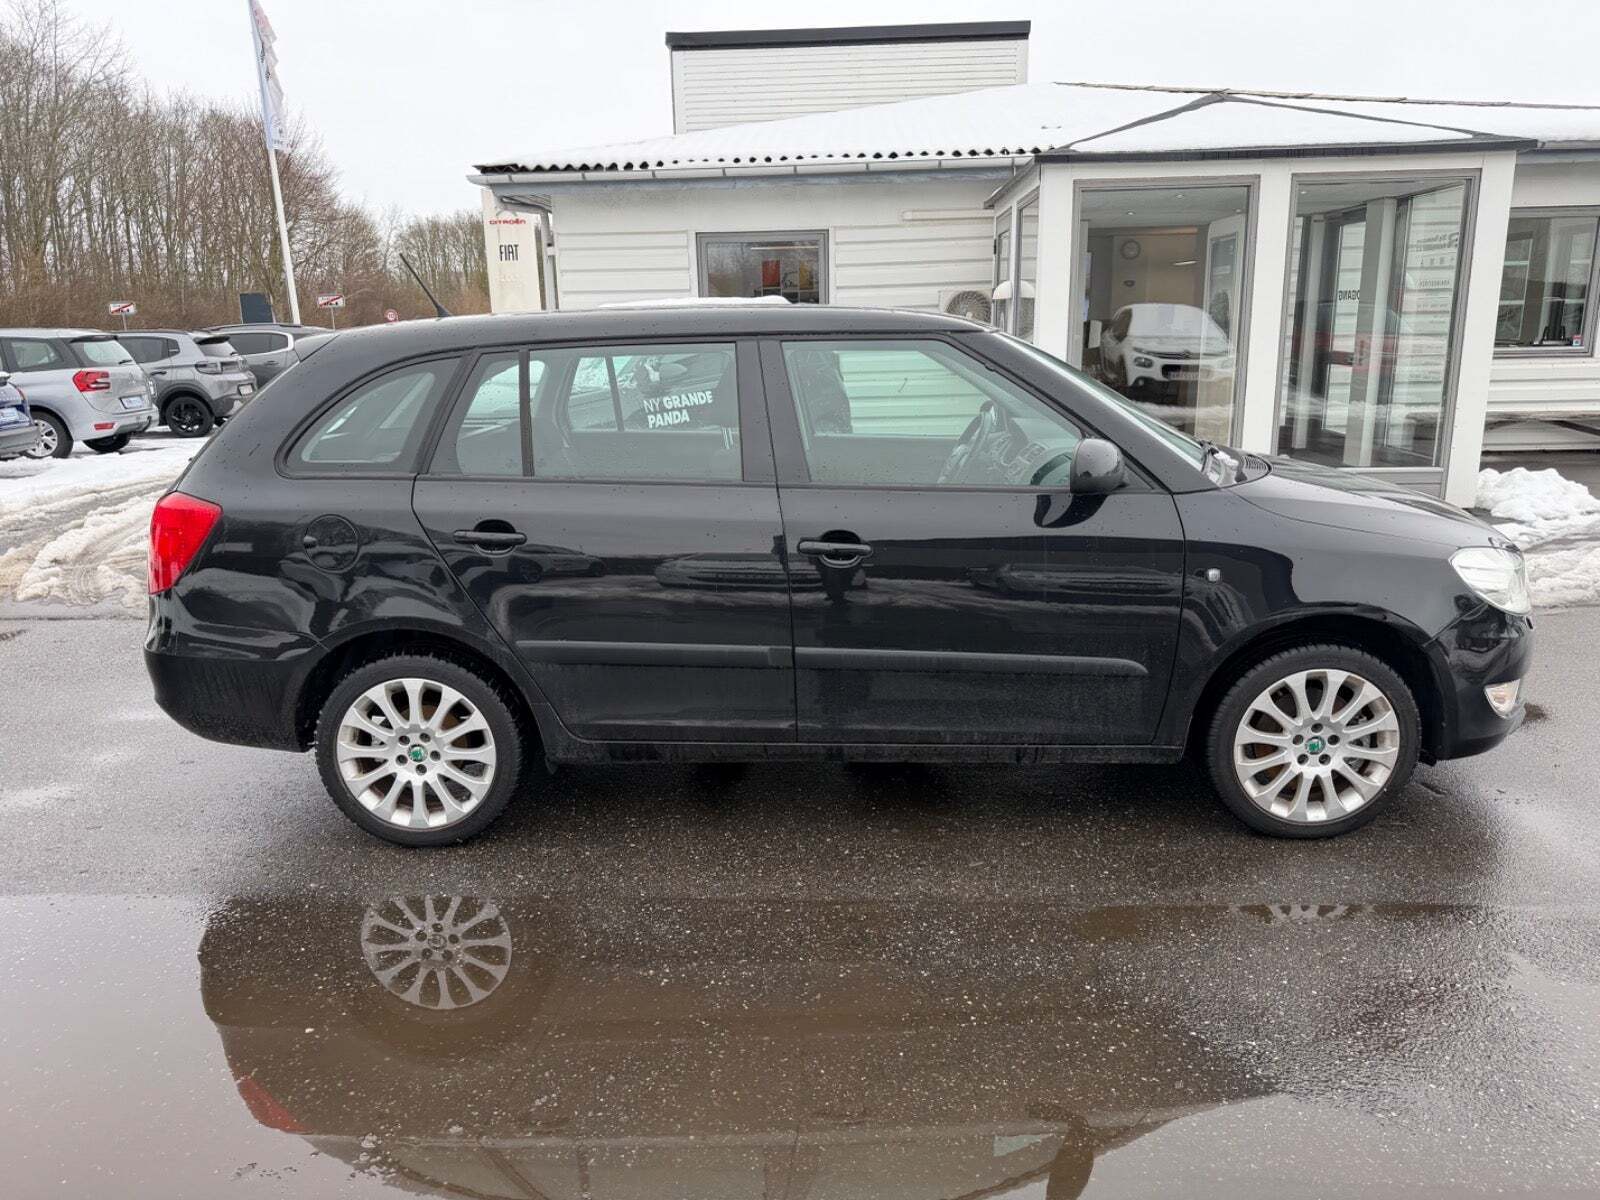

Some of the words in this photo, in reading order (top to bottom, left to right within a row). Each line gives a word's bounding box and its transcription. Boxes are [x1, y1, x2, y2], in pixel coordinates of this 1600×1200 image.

[499, 244, 519, 261] FIAT
[662, 390, 713, 410] GRANDE
[647, 409, 690, 429] PANDA
